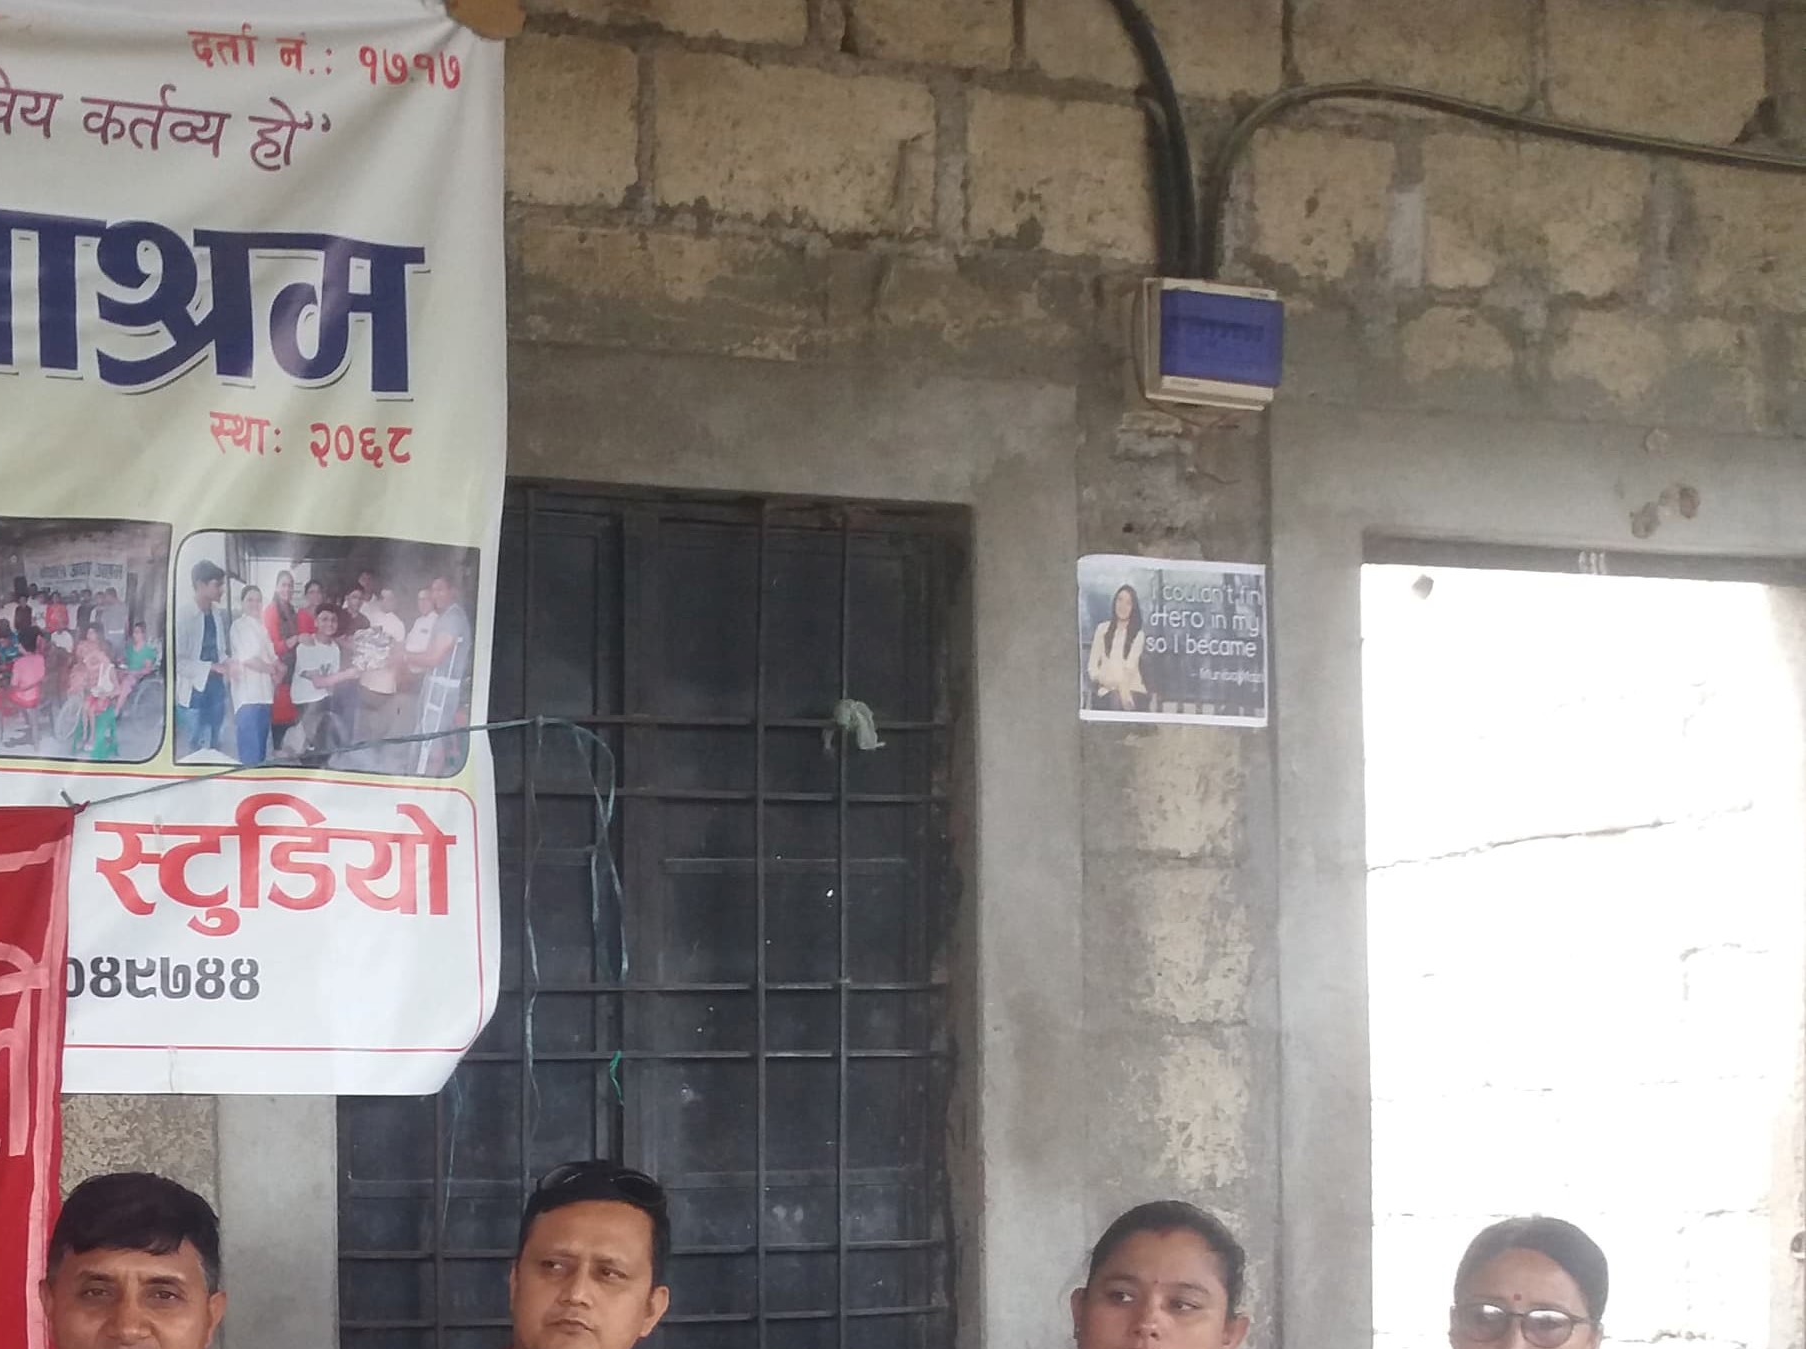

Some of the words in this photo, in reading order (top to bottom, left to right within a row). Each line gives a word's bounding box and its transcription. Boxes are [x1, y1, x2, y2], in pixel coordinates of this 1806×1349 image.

[188, 23, 258, 68] दर्ता
[358, 46, 461, 90] १७१७
[82, 85, 231, 158] कर्तव्य
[309, 421, 413, 468] २०६८
[1146, 635, 1168, 653] so
[1186, 633, 1257, 658] became
[1149, 604, 1205, 629] Hero
[1211, 612, 1227, 630] in
[1232, 614, 1259, 638] my
[95, 793, 458, 938] स्टुडियो
